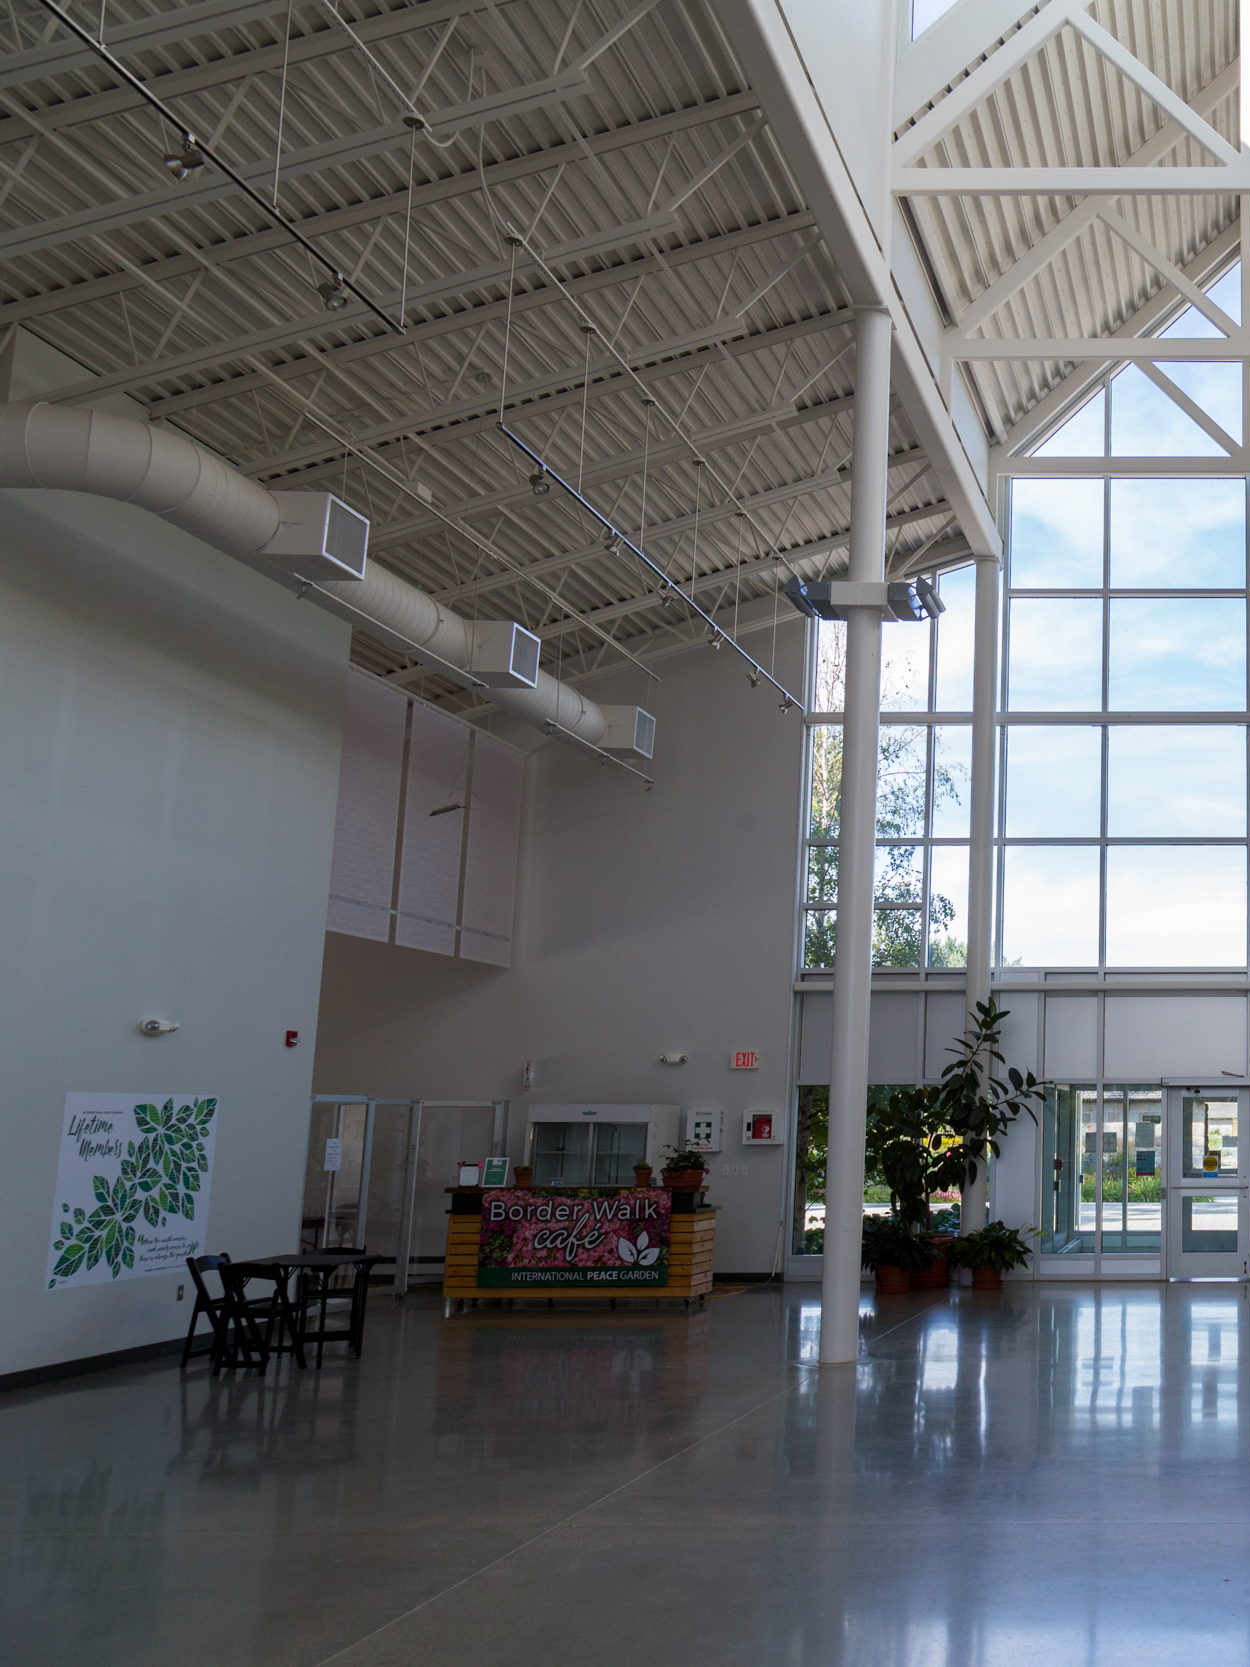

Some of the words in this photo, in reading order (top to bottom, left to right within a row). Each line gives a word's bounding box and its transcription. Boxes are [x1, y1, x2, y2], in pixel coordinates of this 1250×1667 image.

[735, 1052, 755, 1067] EXIT
[67, 1115, 113, 1143] Lifetime
[79, 1138, 123, 1162] Members
[490, 1201, 583, 1221] Border
[592, 1199, 658, 1220] Walk
[533, 1212, 605, 1262] café
[511, 1271, 585, 1282] INTERNATIONAL
[586, 1270, 618, 1281] PEACE
[620, 1270, 660, 1280] GARDEN
